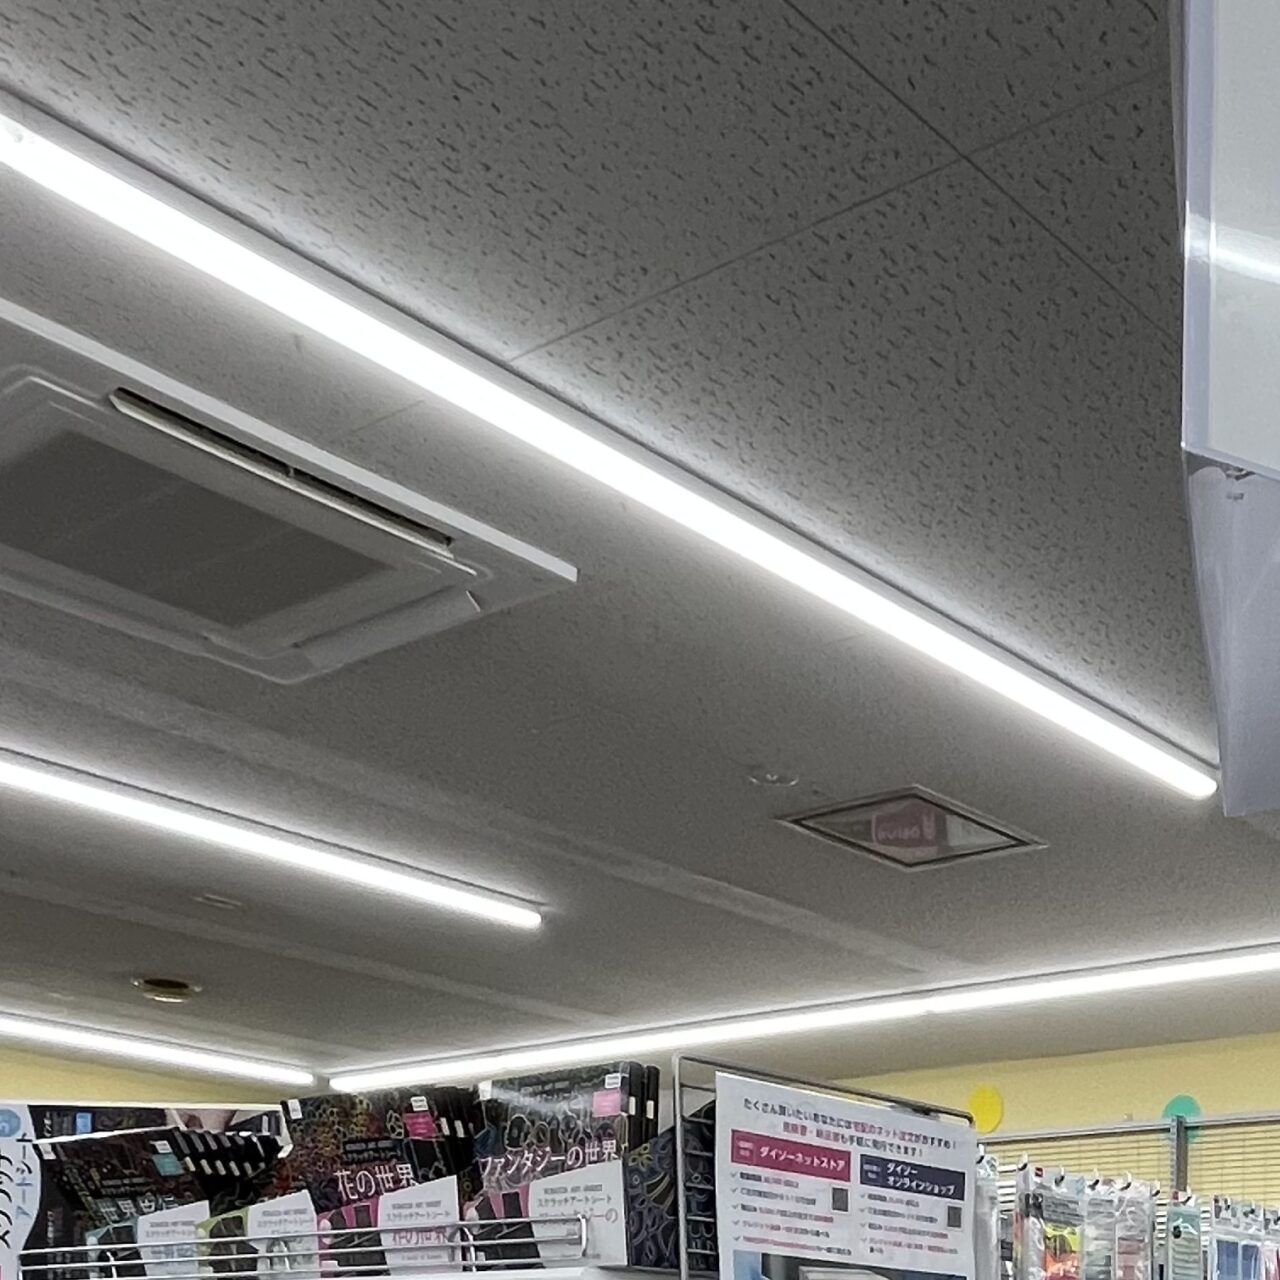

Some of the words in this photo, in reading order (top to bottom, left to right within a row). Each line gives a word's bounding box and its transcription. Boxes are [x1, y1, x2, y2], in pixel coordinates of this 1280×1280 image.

[479, 1139, 619, 1179] ファンタジーの世界
[333, 1162, 418, 1199] 花の世界
